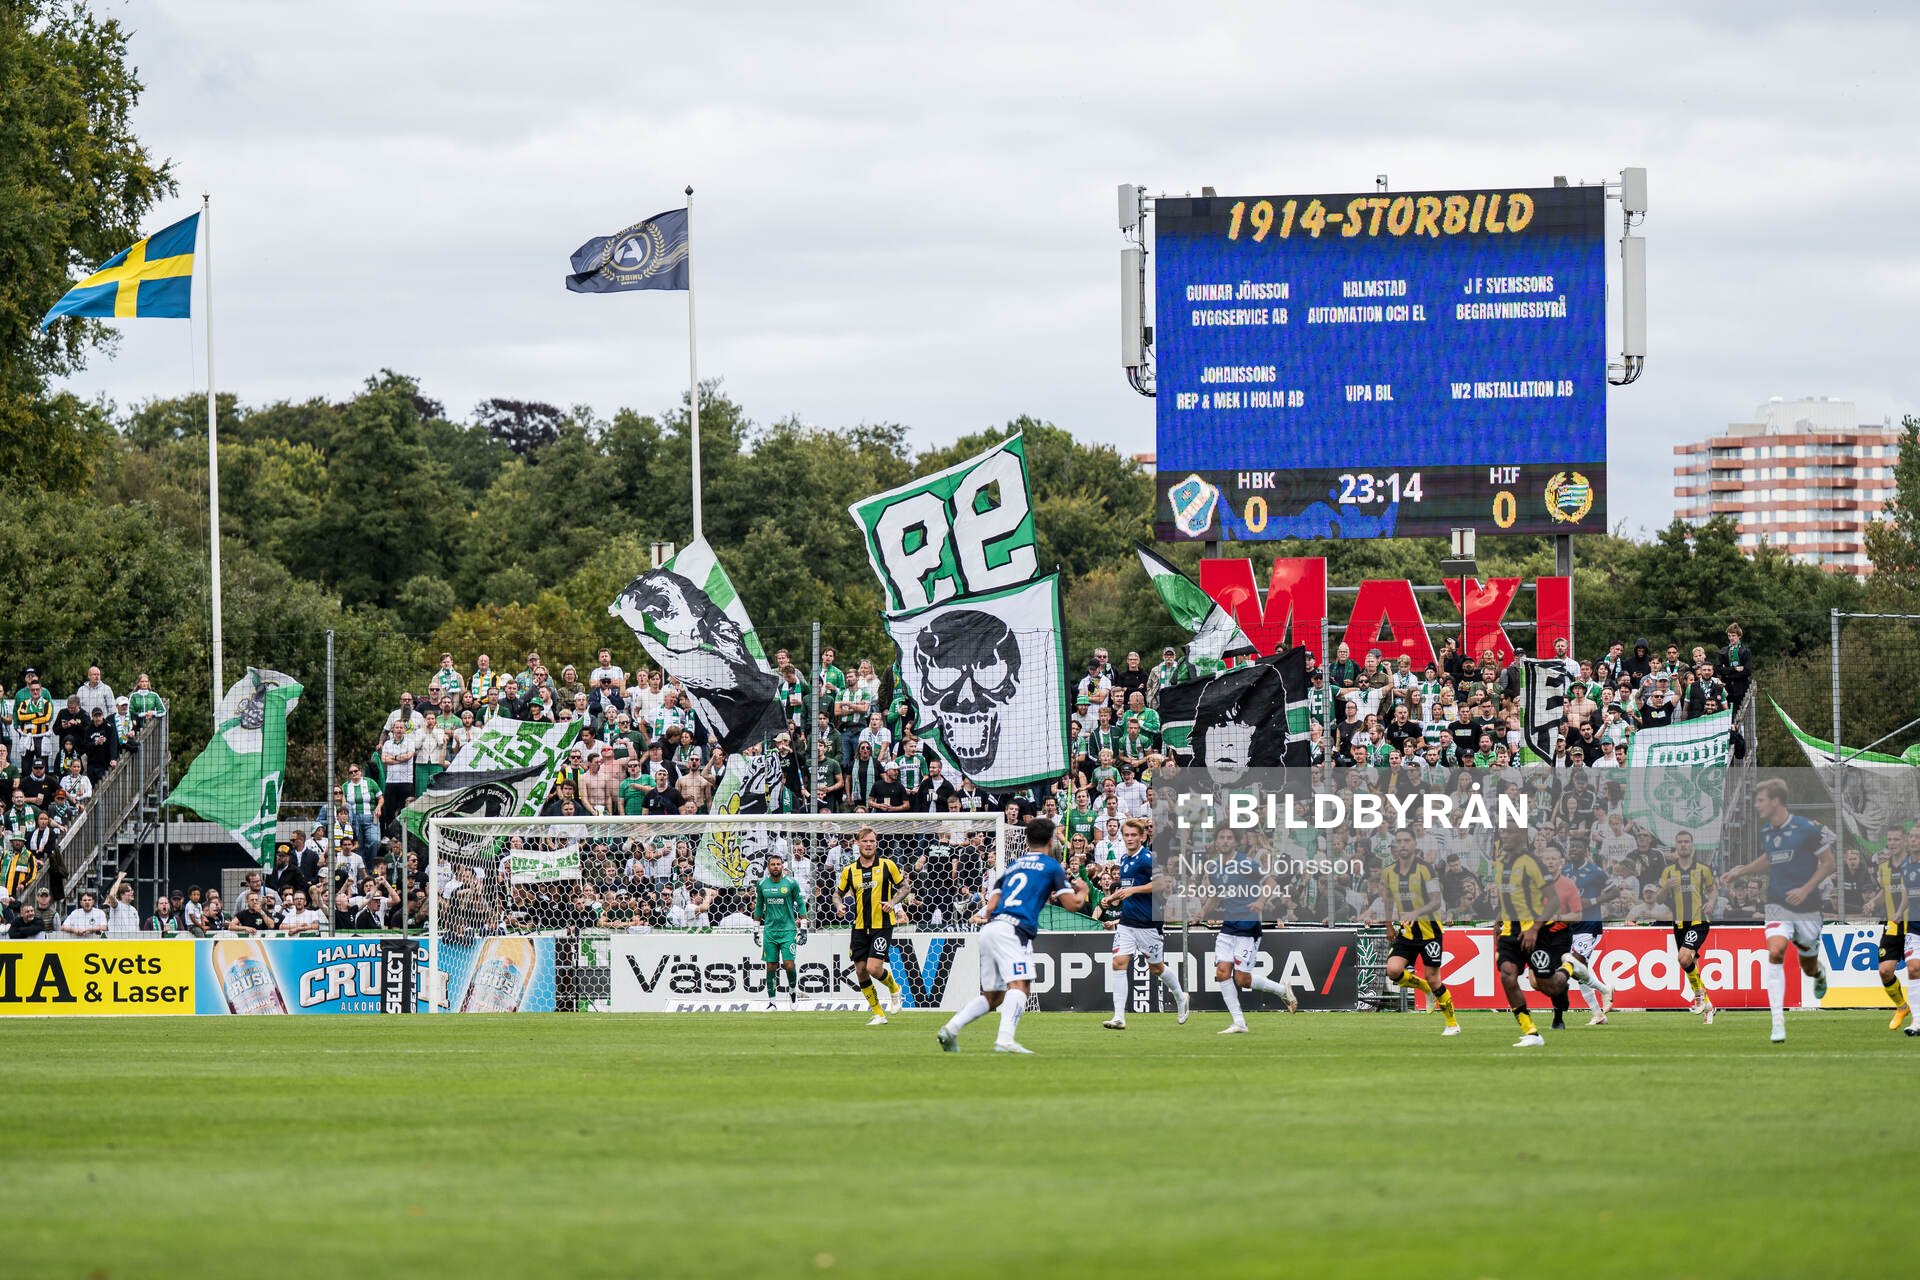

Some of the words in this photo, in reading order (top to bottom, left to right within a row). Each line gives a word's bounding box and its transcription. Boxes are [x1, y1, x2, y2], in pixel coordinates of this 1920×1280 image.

[1228, 193, 1534, 243] 1914-STORBILD
[1186, 284, 1233, 301] GUNNAR
[1235, 280, 1289, 300] JÖNSSON
[1343, 280, 1407, 298] HALMSTAD
[1464, 278, 1472, 294] J
[1475, 277, 1483, 294] F
[1486, 276, 1554, 294] SVENSSONS
[1192, 309, 1268, 326] BYGGSERVICE
[1272, 308, 1288, 325] AB
[1308, 306, 1383, 324] AUTOMATION
[1386, 305, 1409, 322] OCH
[1412, 304, 1426, 321] EL
[1456, 295, 1567, 320] BEGRAVNINGSBYRÅ
[1201, 365, 1276, 383] JOHANSSONS
[1176, 392, 1199, 409] REP
[1202, 394, 1210, 409] &
[1214, 392, 1240, 409] MEK
[1243, 391, 1248, 408] I
[1251, 391, 1285, 408] HOLM
[1288, 390, 1304, 407] AB
[1345, 385, 1372, 401] VIPA
[1375, 385, 1393, 401] BIL
[1451, 382, 1471, 399] W2
[1474, 381, 1554, 399] INSTALLATION
[1557, 380, 1573, 397] AB
[1238, 472, 1276, 489] HBK
[1489, 467, 1520, 484] HIF
[1338, 472, 1423, 504] 23:14
[1244, 496, 1268, 533] 0
[1493, 491, 1516, 528] 0
[1200, 557, 1573, 673] MAXI
[1004, 873, 1027, 907] 2
[1148, 944, 1159, 954] 29
[1822, 930, 1907, 971] Vä
[84, 953, 161, 975] Svets
[84, 982, 102, 1003] &
[113, 982, 189, 1003] Laser
[386, 951, 404, 1014] SELECT
[1134, 951, 1150, 1013] SELEC
[341, 1001, 381, 1012] ALKOHO
